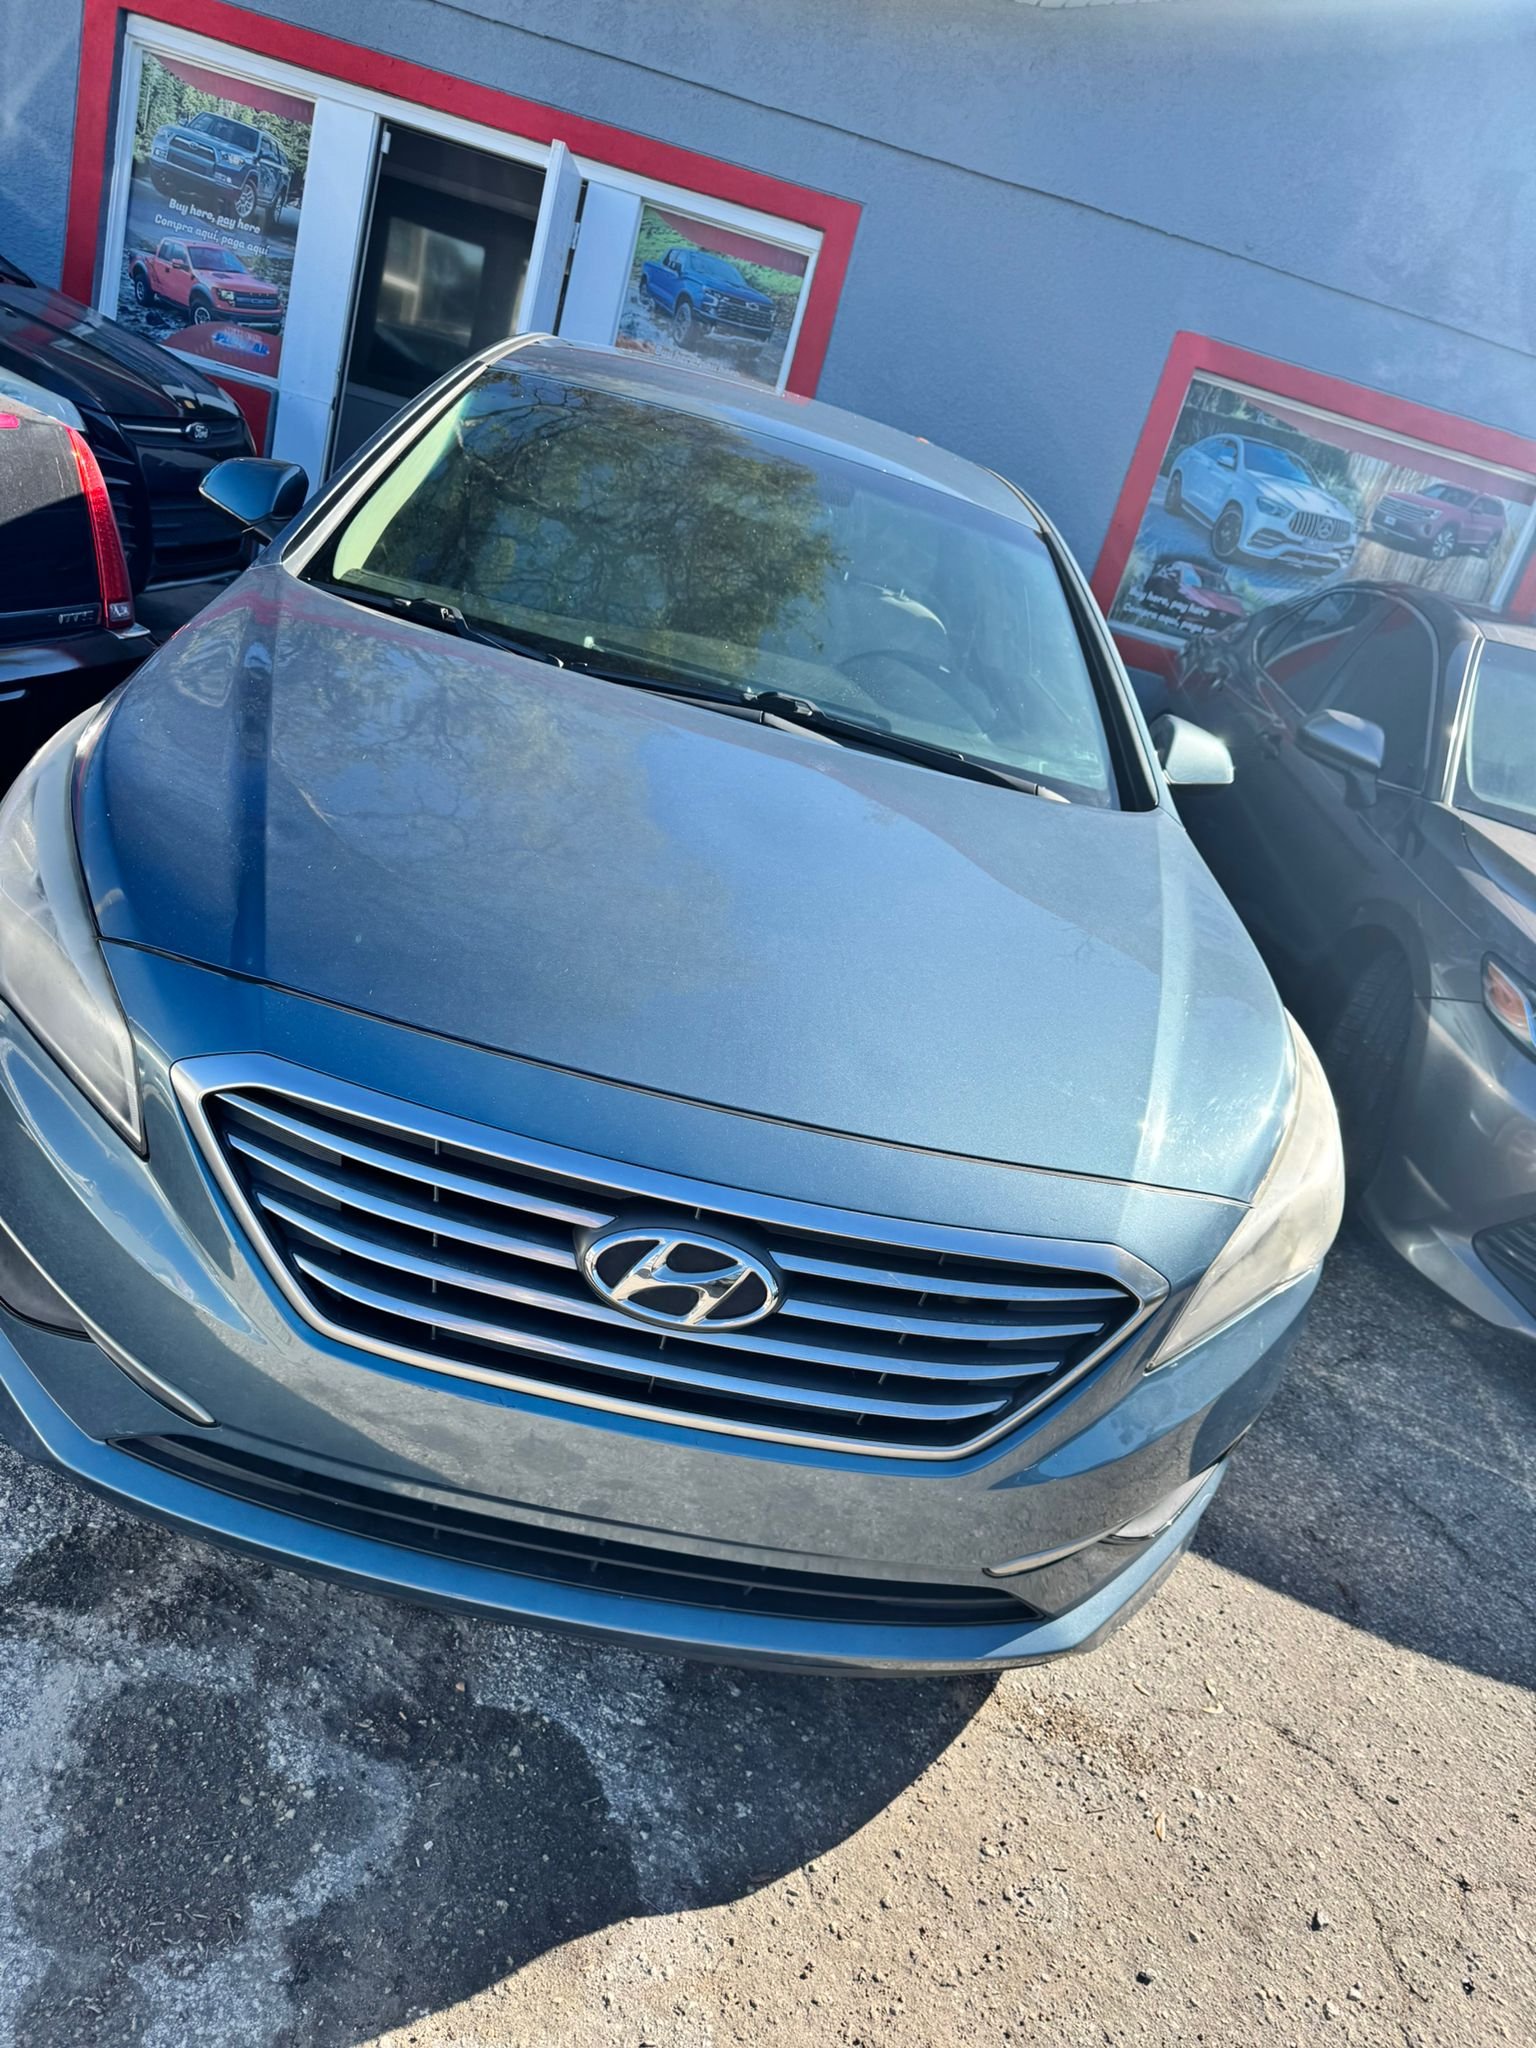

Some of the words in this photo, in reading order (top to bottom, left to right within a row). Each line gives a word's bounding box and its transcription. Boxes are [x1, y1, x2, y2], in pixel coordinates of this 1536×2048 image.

[155, 214, 193, 233] Compra
[221, 235, 245, 249] paga
[169, 198, 188, 216] Buy
[190, 204, 214, 223] here,
[217, 215, 236, 230] pay
[238, 218, 261, 234] here
